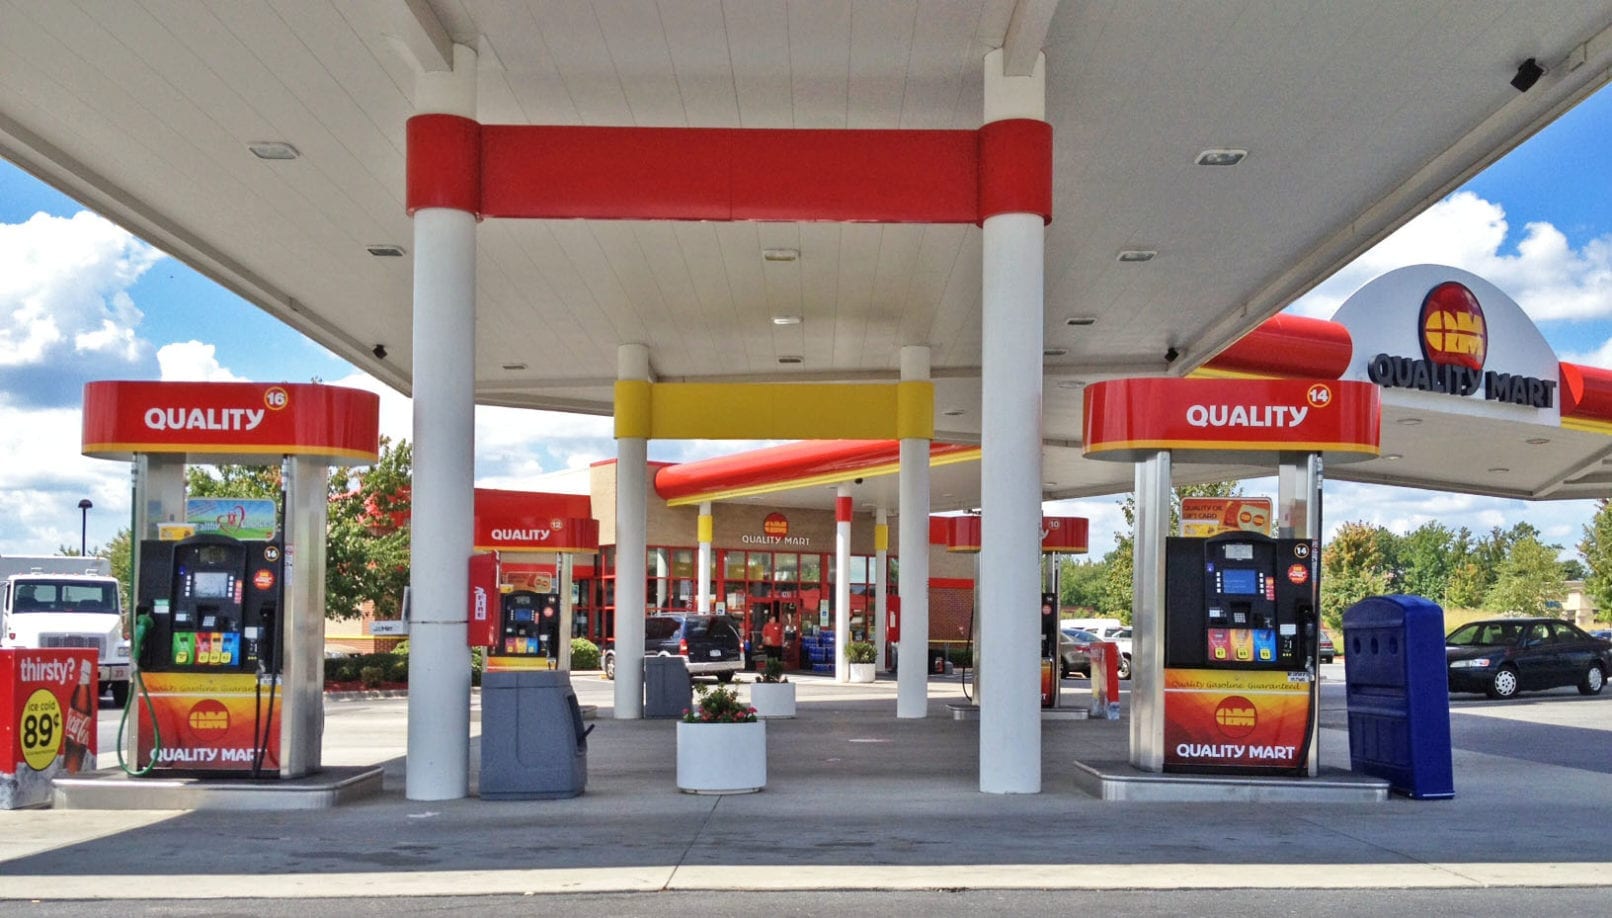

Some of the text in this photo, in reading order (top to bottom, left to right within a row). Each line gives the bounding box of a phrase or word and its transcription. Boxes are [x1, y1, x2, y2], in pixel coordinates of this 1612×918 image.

[1368, 353, 1557, 408] QUALITY MART
[267, 391, 285, 405] 16
[1310, 389, 1328, 402] 14
[144, 407, 265, 431] QUALITY
[1186, 404, 1308, 428] QUALITY
[491, 528, 550, 541] QUALITY
[742, 534, 810, 546] QUALITY MART
[20, 657, 76, 686] thirsty?
[1172, 681, 1302, 691] Quality Gasoline Guaranteed
[28, 701, 55, 712] ice cold
[150, 747, 267, 762] QUALITY MAR
[1176, 743, 1296, 759] QUALITY MART
